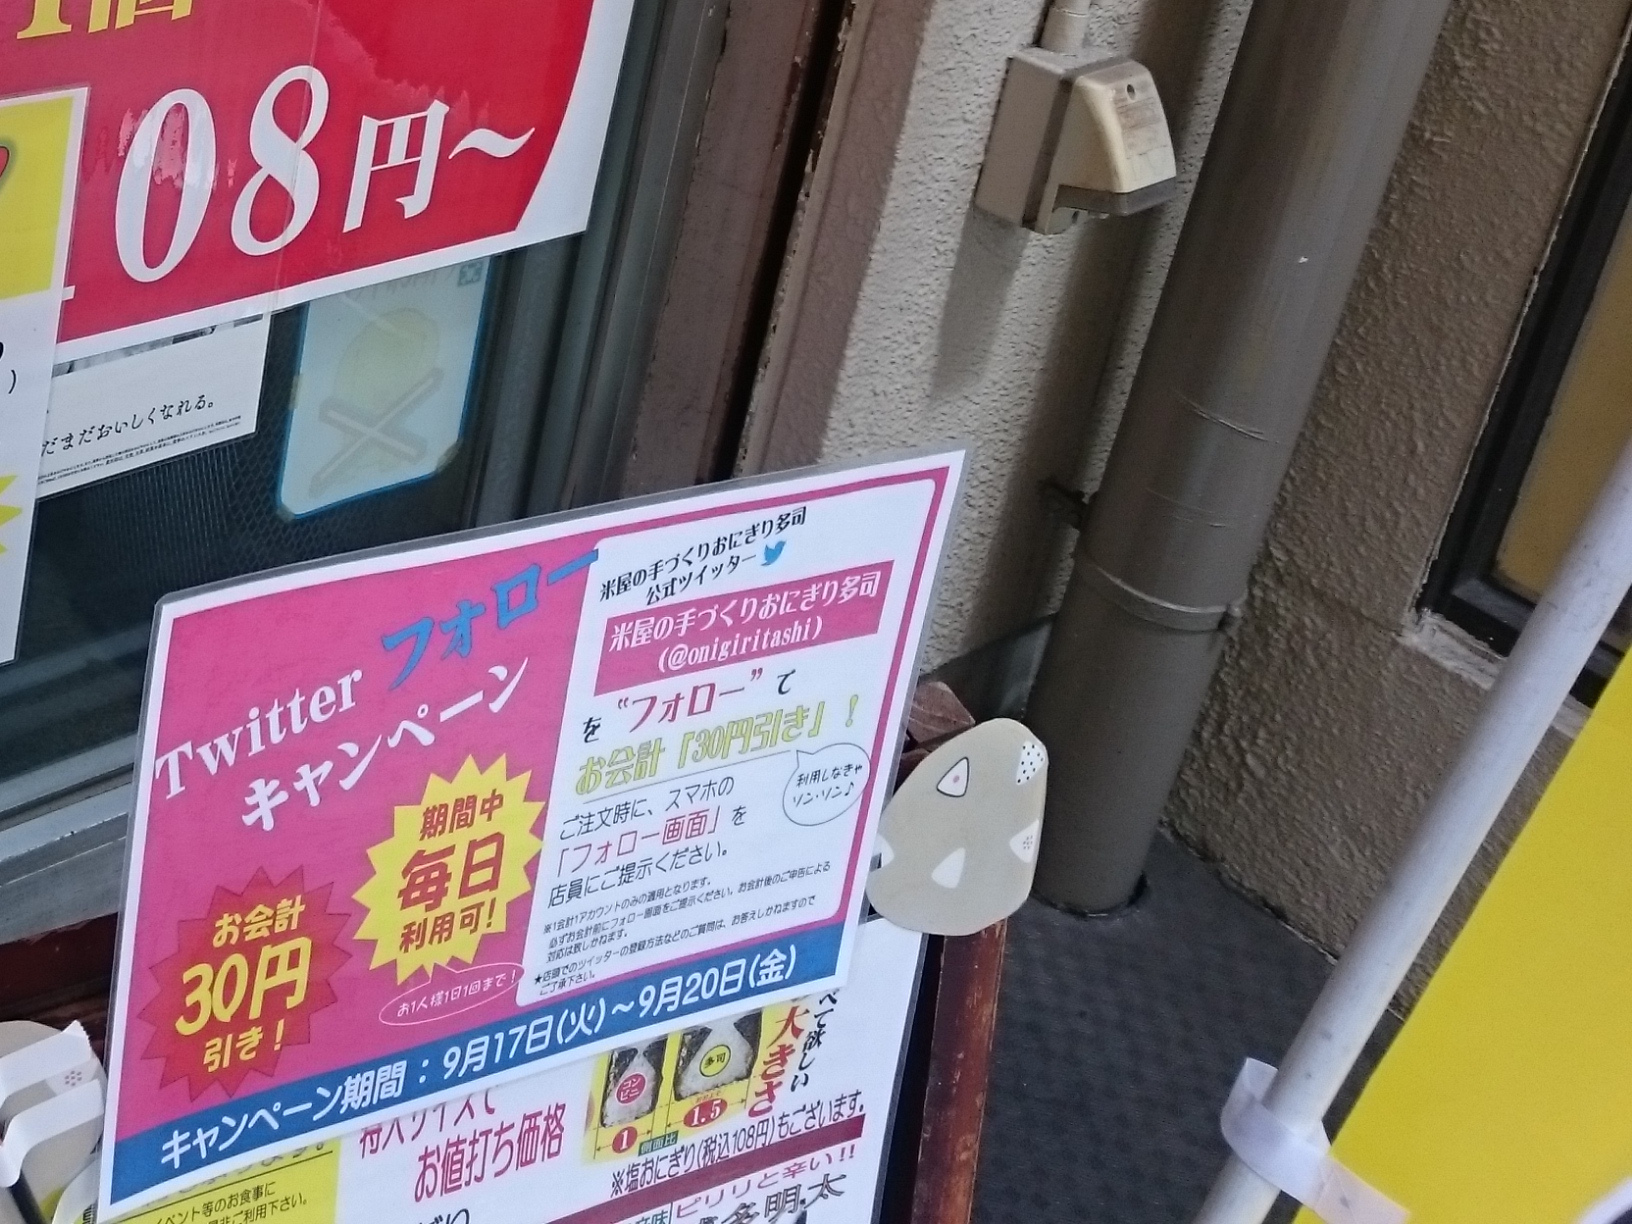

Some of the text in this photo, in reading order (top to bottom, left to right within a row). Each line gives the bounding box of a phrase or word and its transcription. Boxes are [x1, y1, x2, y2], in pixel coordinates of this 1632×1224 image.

[58, 63, 536, 302] 08円~
[599, 506, 807, 603] 米屋の手づくりおにぎり多司
[645, 551, 758, 606] 公式ツイッター
[608, 570, 881, 654] 米屋の手づくりおにぎり多司
[658, 616, 824, 672] (@onigiritashi)
[154, 548, 599, 801] Twitter フォロー
[241, 657, 529, 833] キャンペーン
[419, 789, 505, 842] 期間中
[561, 775, 735, 840] ご注文時に、スマホの
[398, 831, 505, 915] 毎日
[548, 841, 729, 909] 店員にご提示ください。
[212, 895, 306, 948] お会計
[400, 897, 497, 954] 利用可!
[174, 936, 313, 1036] 30円
[397, 969, 517, 1018] お1人様1日1回まで!
[202, 1020, 285, 1073] 引き!
[691, 1100, 722, 1125] 1.5
[414, 1102, 567, 1203] お値打ち価格
